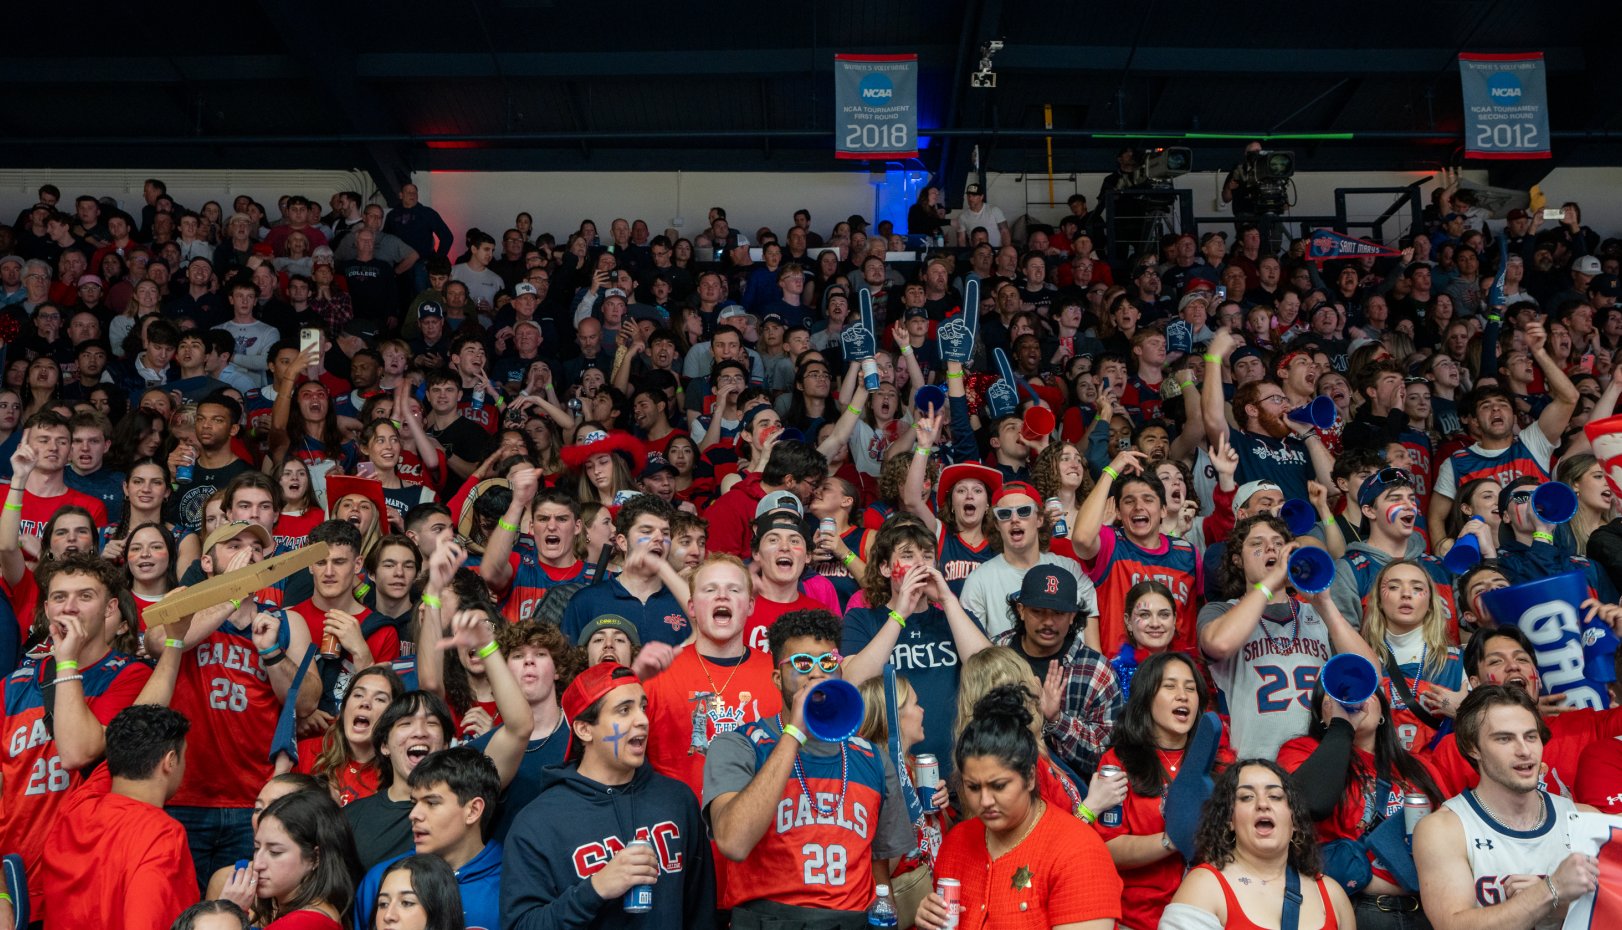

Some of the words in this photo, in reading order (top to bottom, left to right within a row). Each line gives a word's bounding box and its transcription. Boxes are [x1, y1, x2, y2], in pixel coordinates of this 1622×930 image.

[862, 88, 893, 98] NCAA
[1491, 87, 1521, 97] NCAA
[864, 105, 910, 113] TOURNAMENT
[845, 123, 908, 148] 2018
[1476, 123, 1539, 148] 2012
[1339, 240, 1356, 254] SAINT
[348, 271, 377, 279] COLLEGE
[1044, 575, 1060, 595] B
[197, 642, 269, 682] GAELS
[209, 677, 249, 713] 28
[1253, 665, 1322, 714] 25
[708, 706, 745, 722] BEAT
[715, 723, 737, 734] THE
[24, 755, 71, 796] 28
[777, 791, 868, 839] GAELS
[802, 842, 848, 886] 28
